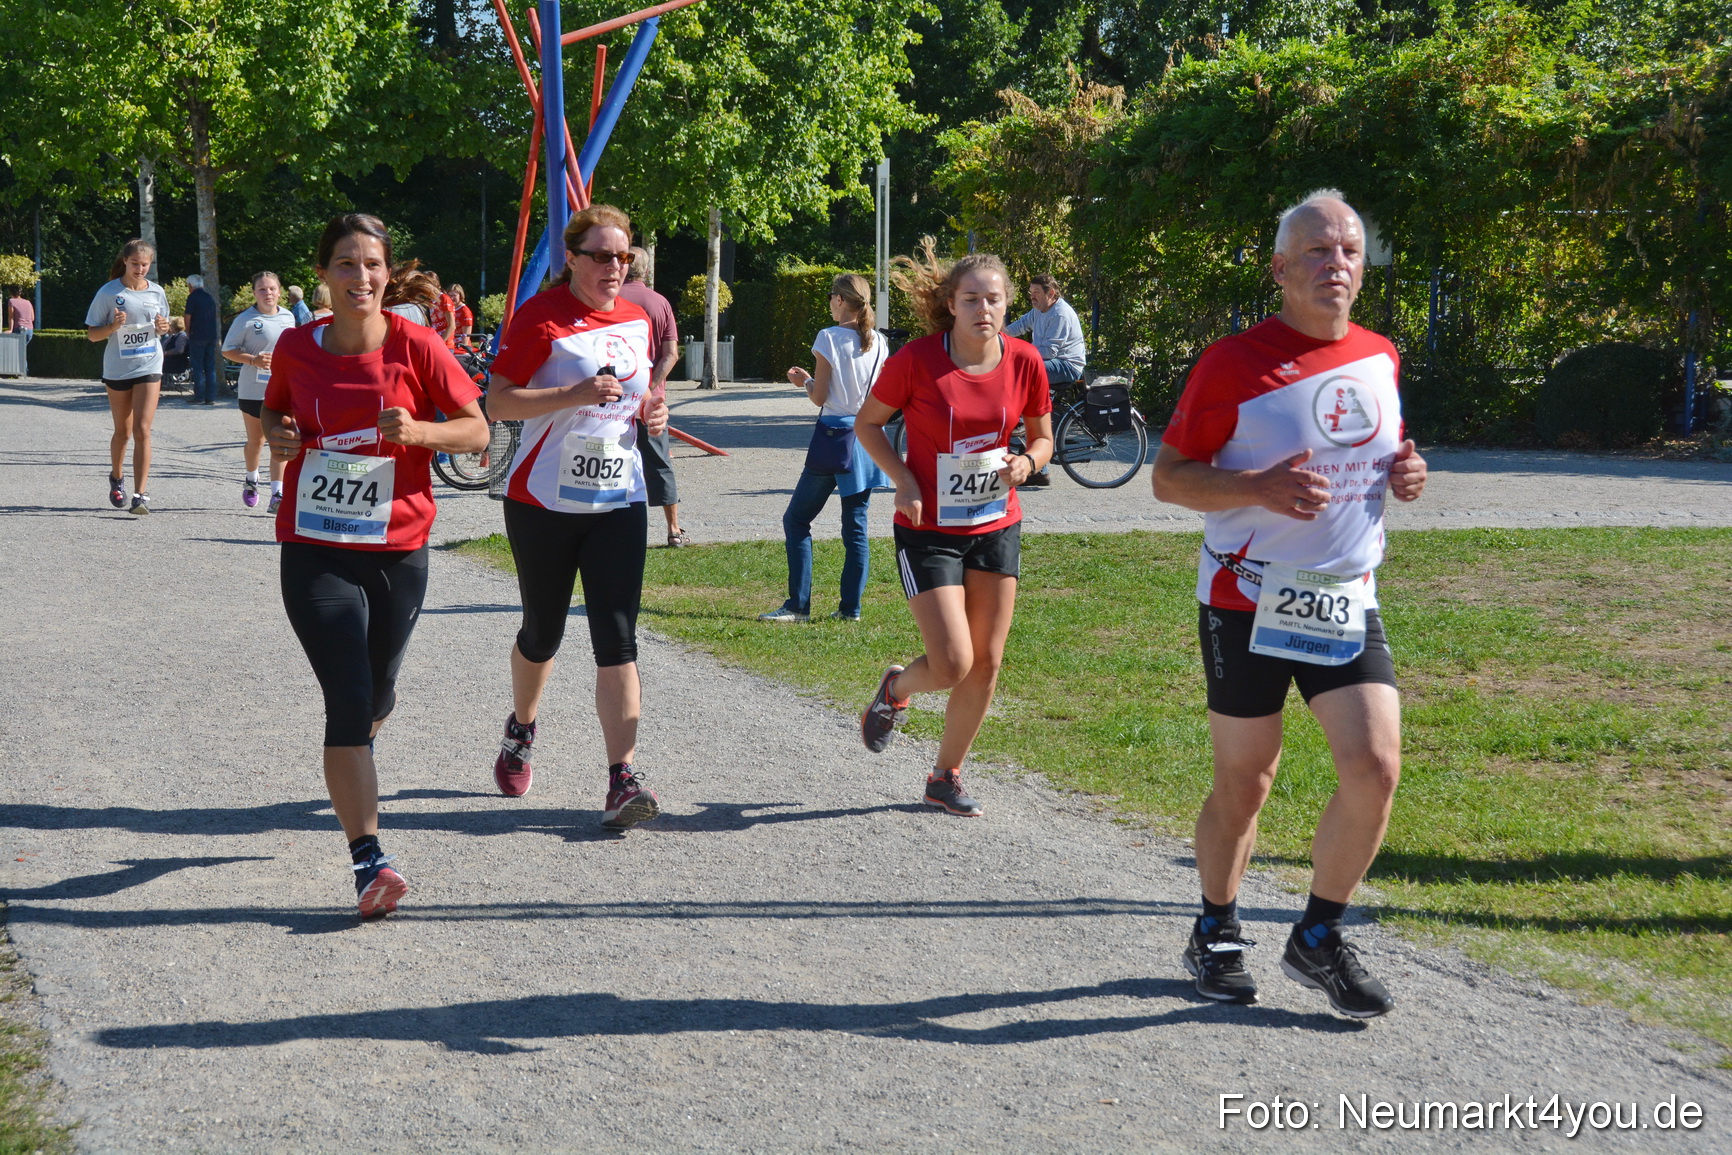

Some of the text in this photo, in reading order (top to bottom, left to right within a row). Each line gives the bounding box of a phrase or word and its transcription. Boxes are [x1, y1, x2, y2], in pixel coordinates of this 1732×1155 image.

[124, 332, 149, 345] 2067
[337, 436, 362, 446] DEHN
[965, 439, 985, 449] DEHN
[328, 459, 368, 472] BOCK
[571, 455, 624, 479] 3052
[1345, 462, 1368, 472] MIT
[949, 470, 1000, 496] 2472
[1349, 479, 1360, 488] Dr.
[311, 475, 379, 507] 2474
[315, 504, 364, 516] PARTL Neumarkt
[323, 518, 360, 533] Blaser
[1297, 570, 1340, 585] BOCK
[1274, 587, 1350, 626] 2303
[1279, 619, 1335, 635] PARTL Neumarkt
[1285, 634, 1331, 655] Jürgen
[1211, 633, 1225, 679] odlo
